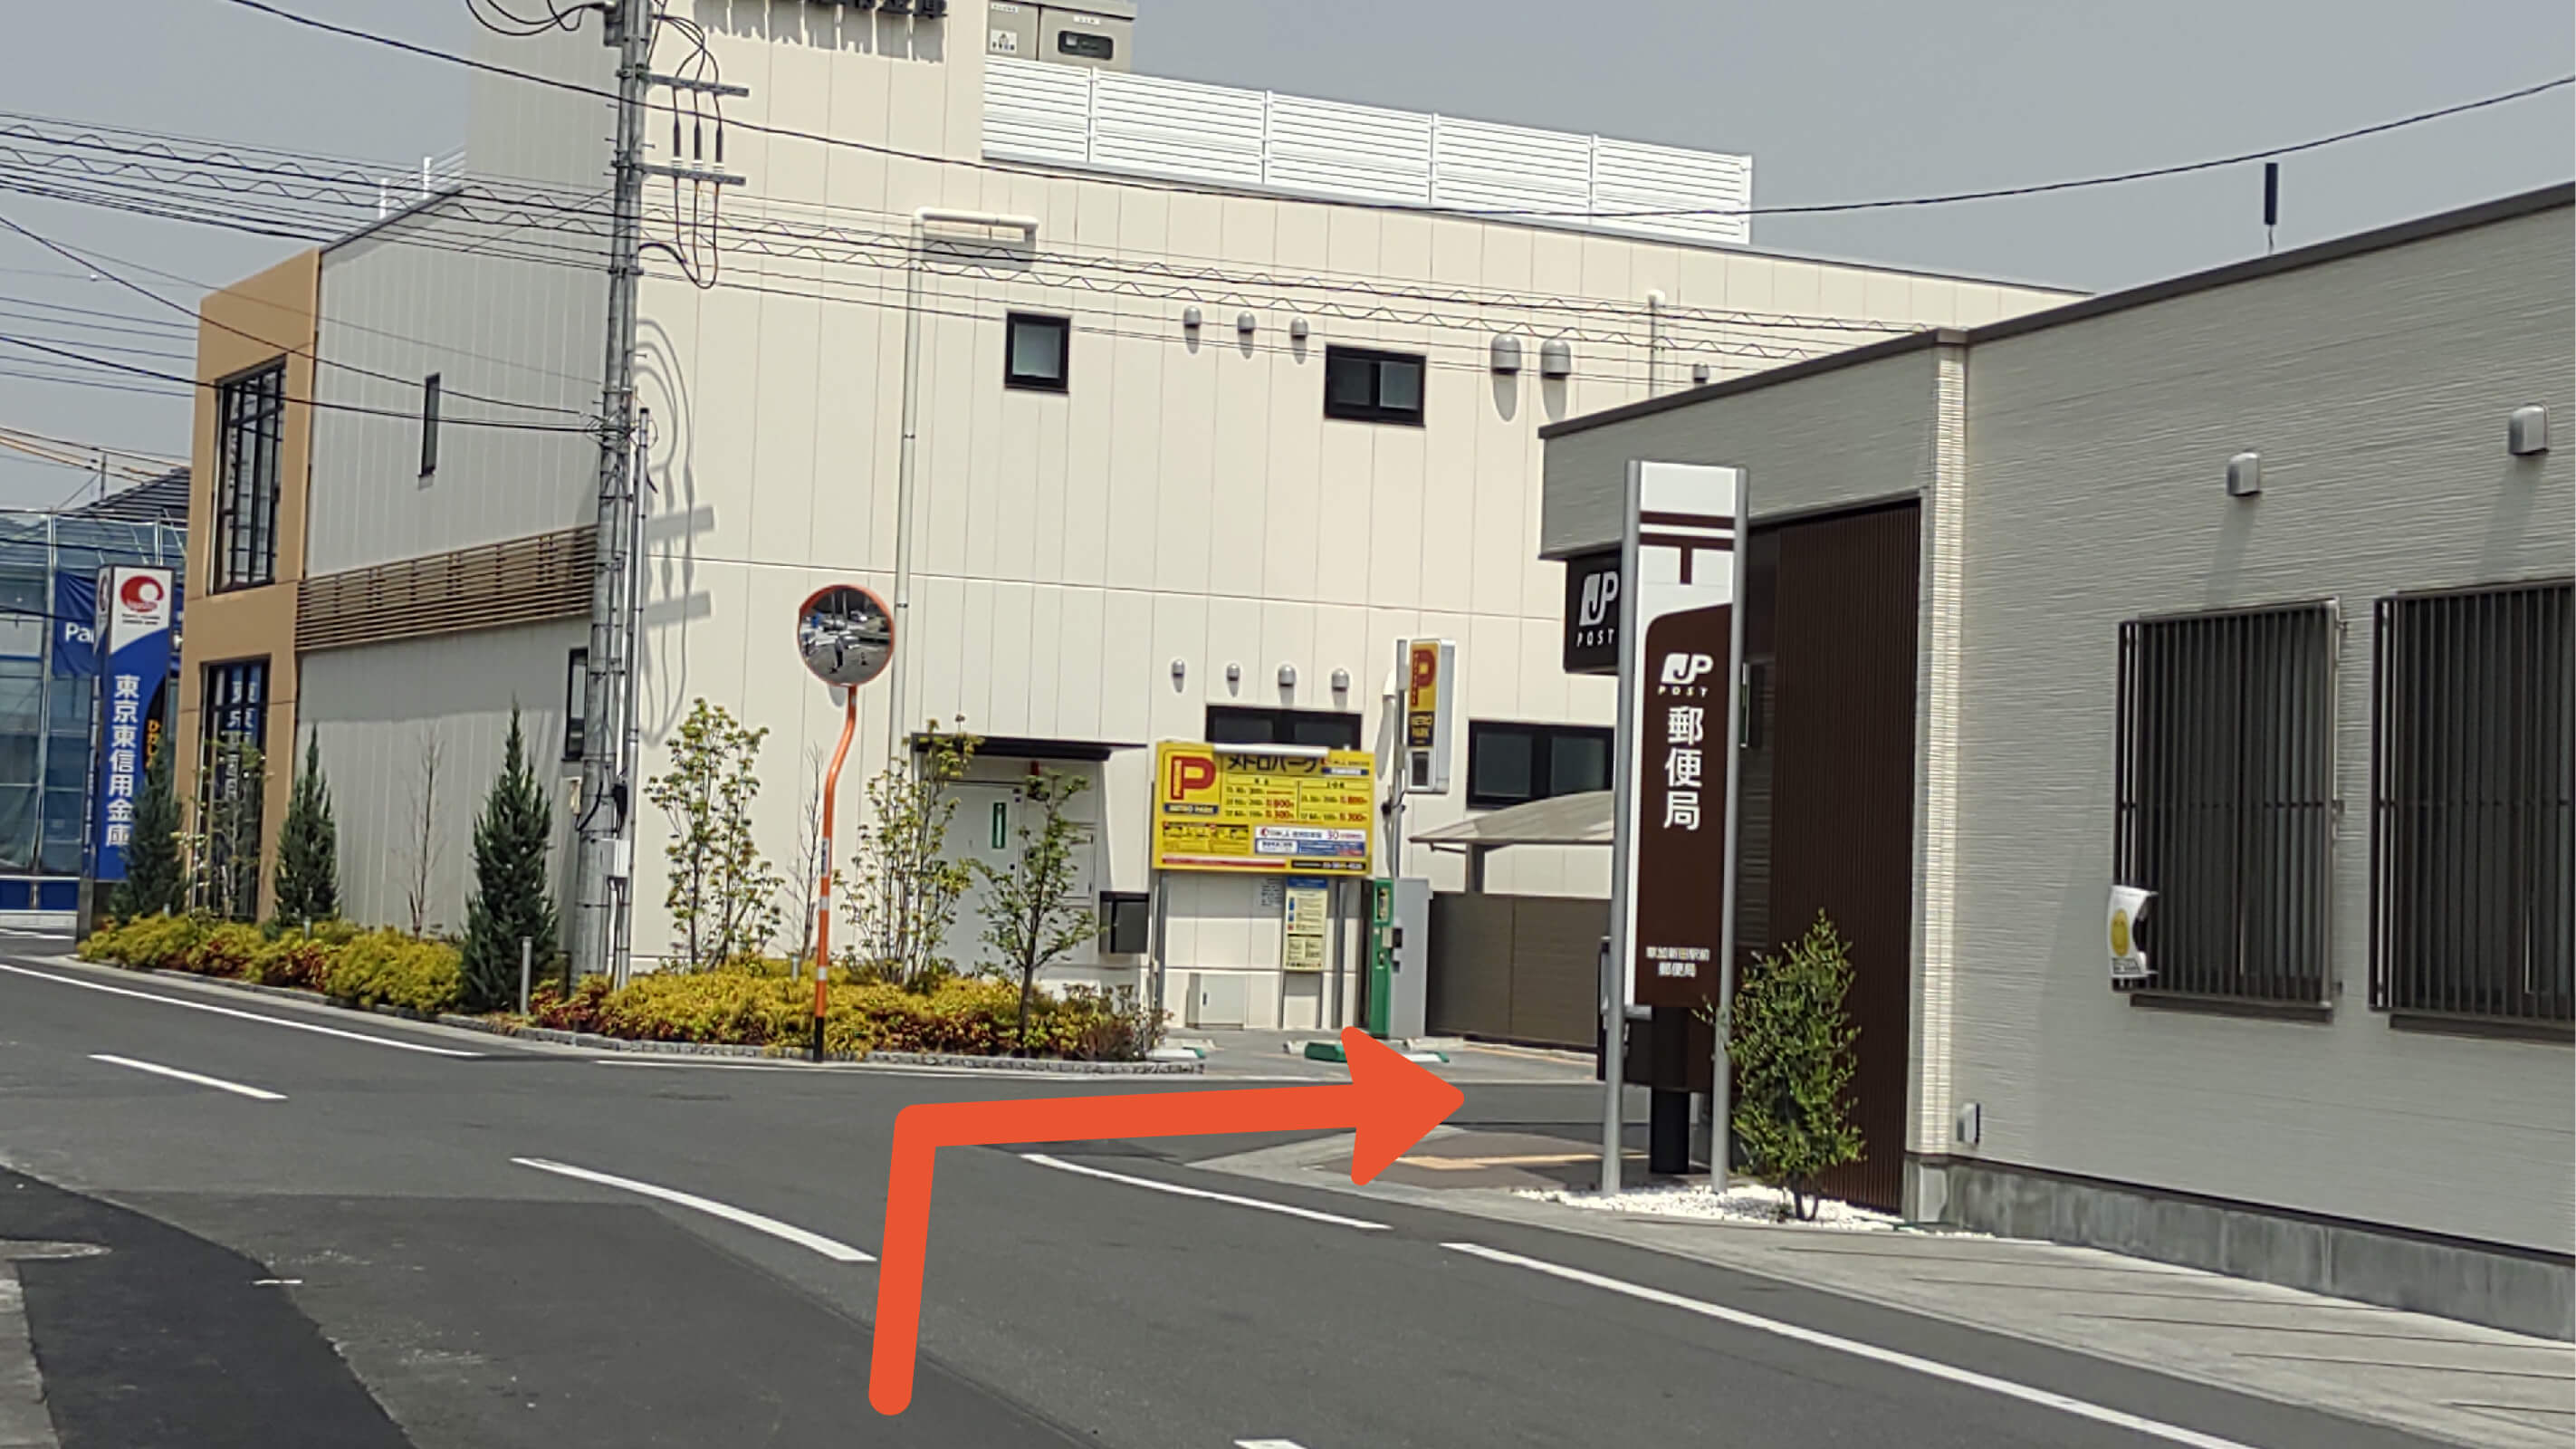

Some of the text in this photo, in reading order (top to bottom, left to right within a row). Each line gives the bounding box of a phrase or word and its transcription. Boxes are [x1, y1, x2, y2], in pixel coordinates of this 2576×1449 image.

[1576, 628, 1614, 648] POST
[1657, 686, 1708, 697] POST
[106, 675, 140, 848] 東京東信用金庫
[1170, 756, 1216, 800] P
[1663, 705, 1704, 830] 郵便局
